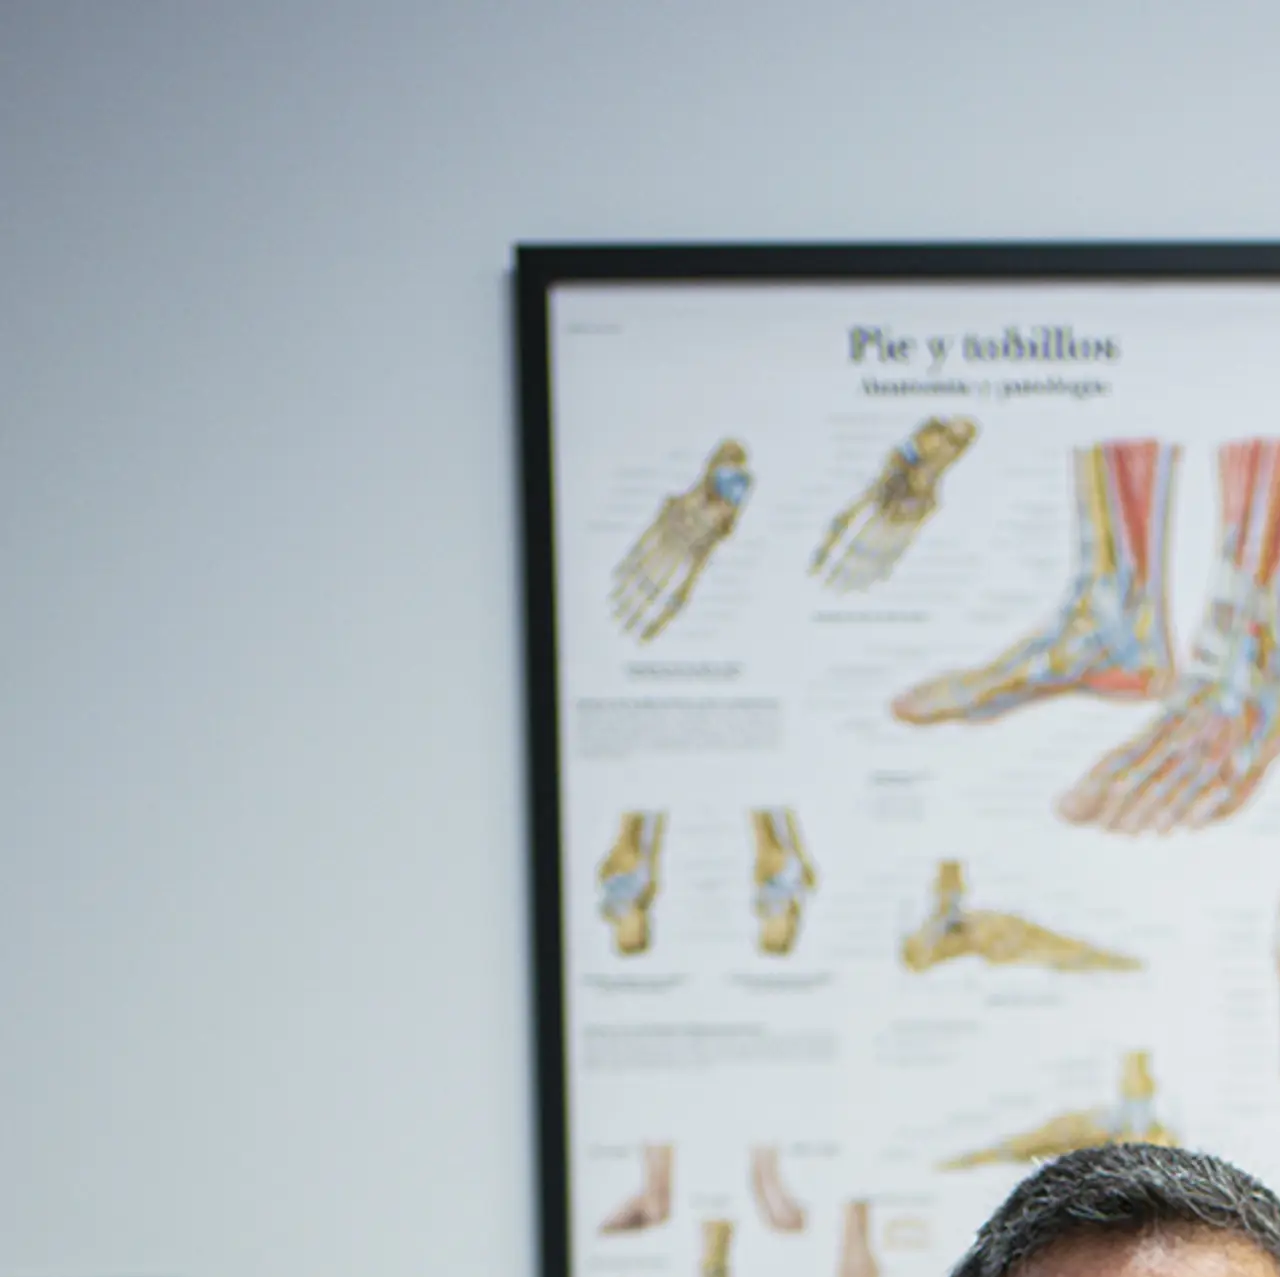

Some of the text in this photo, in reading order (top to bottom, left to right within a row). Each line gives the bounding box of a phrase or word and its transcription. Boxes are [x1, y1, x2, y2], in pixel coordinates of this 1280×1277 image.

[849, 325, 1122, 376] Pie y tobillos
